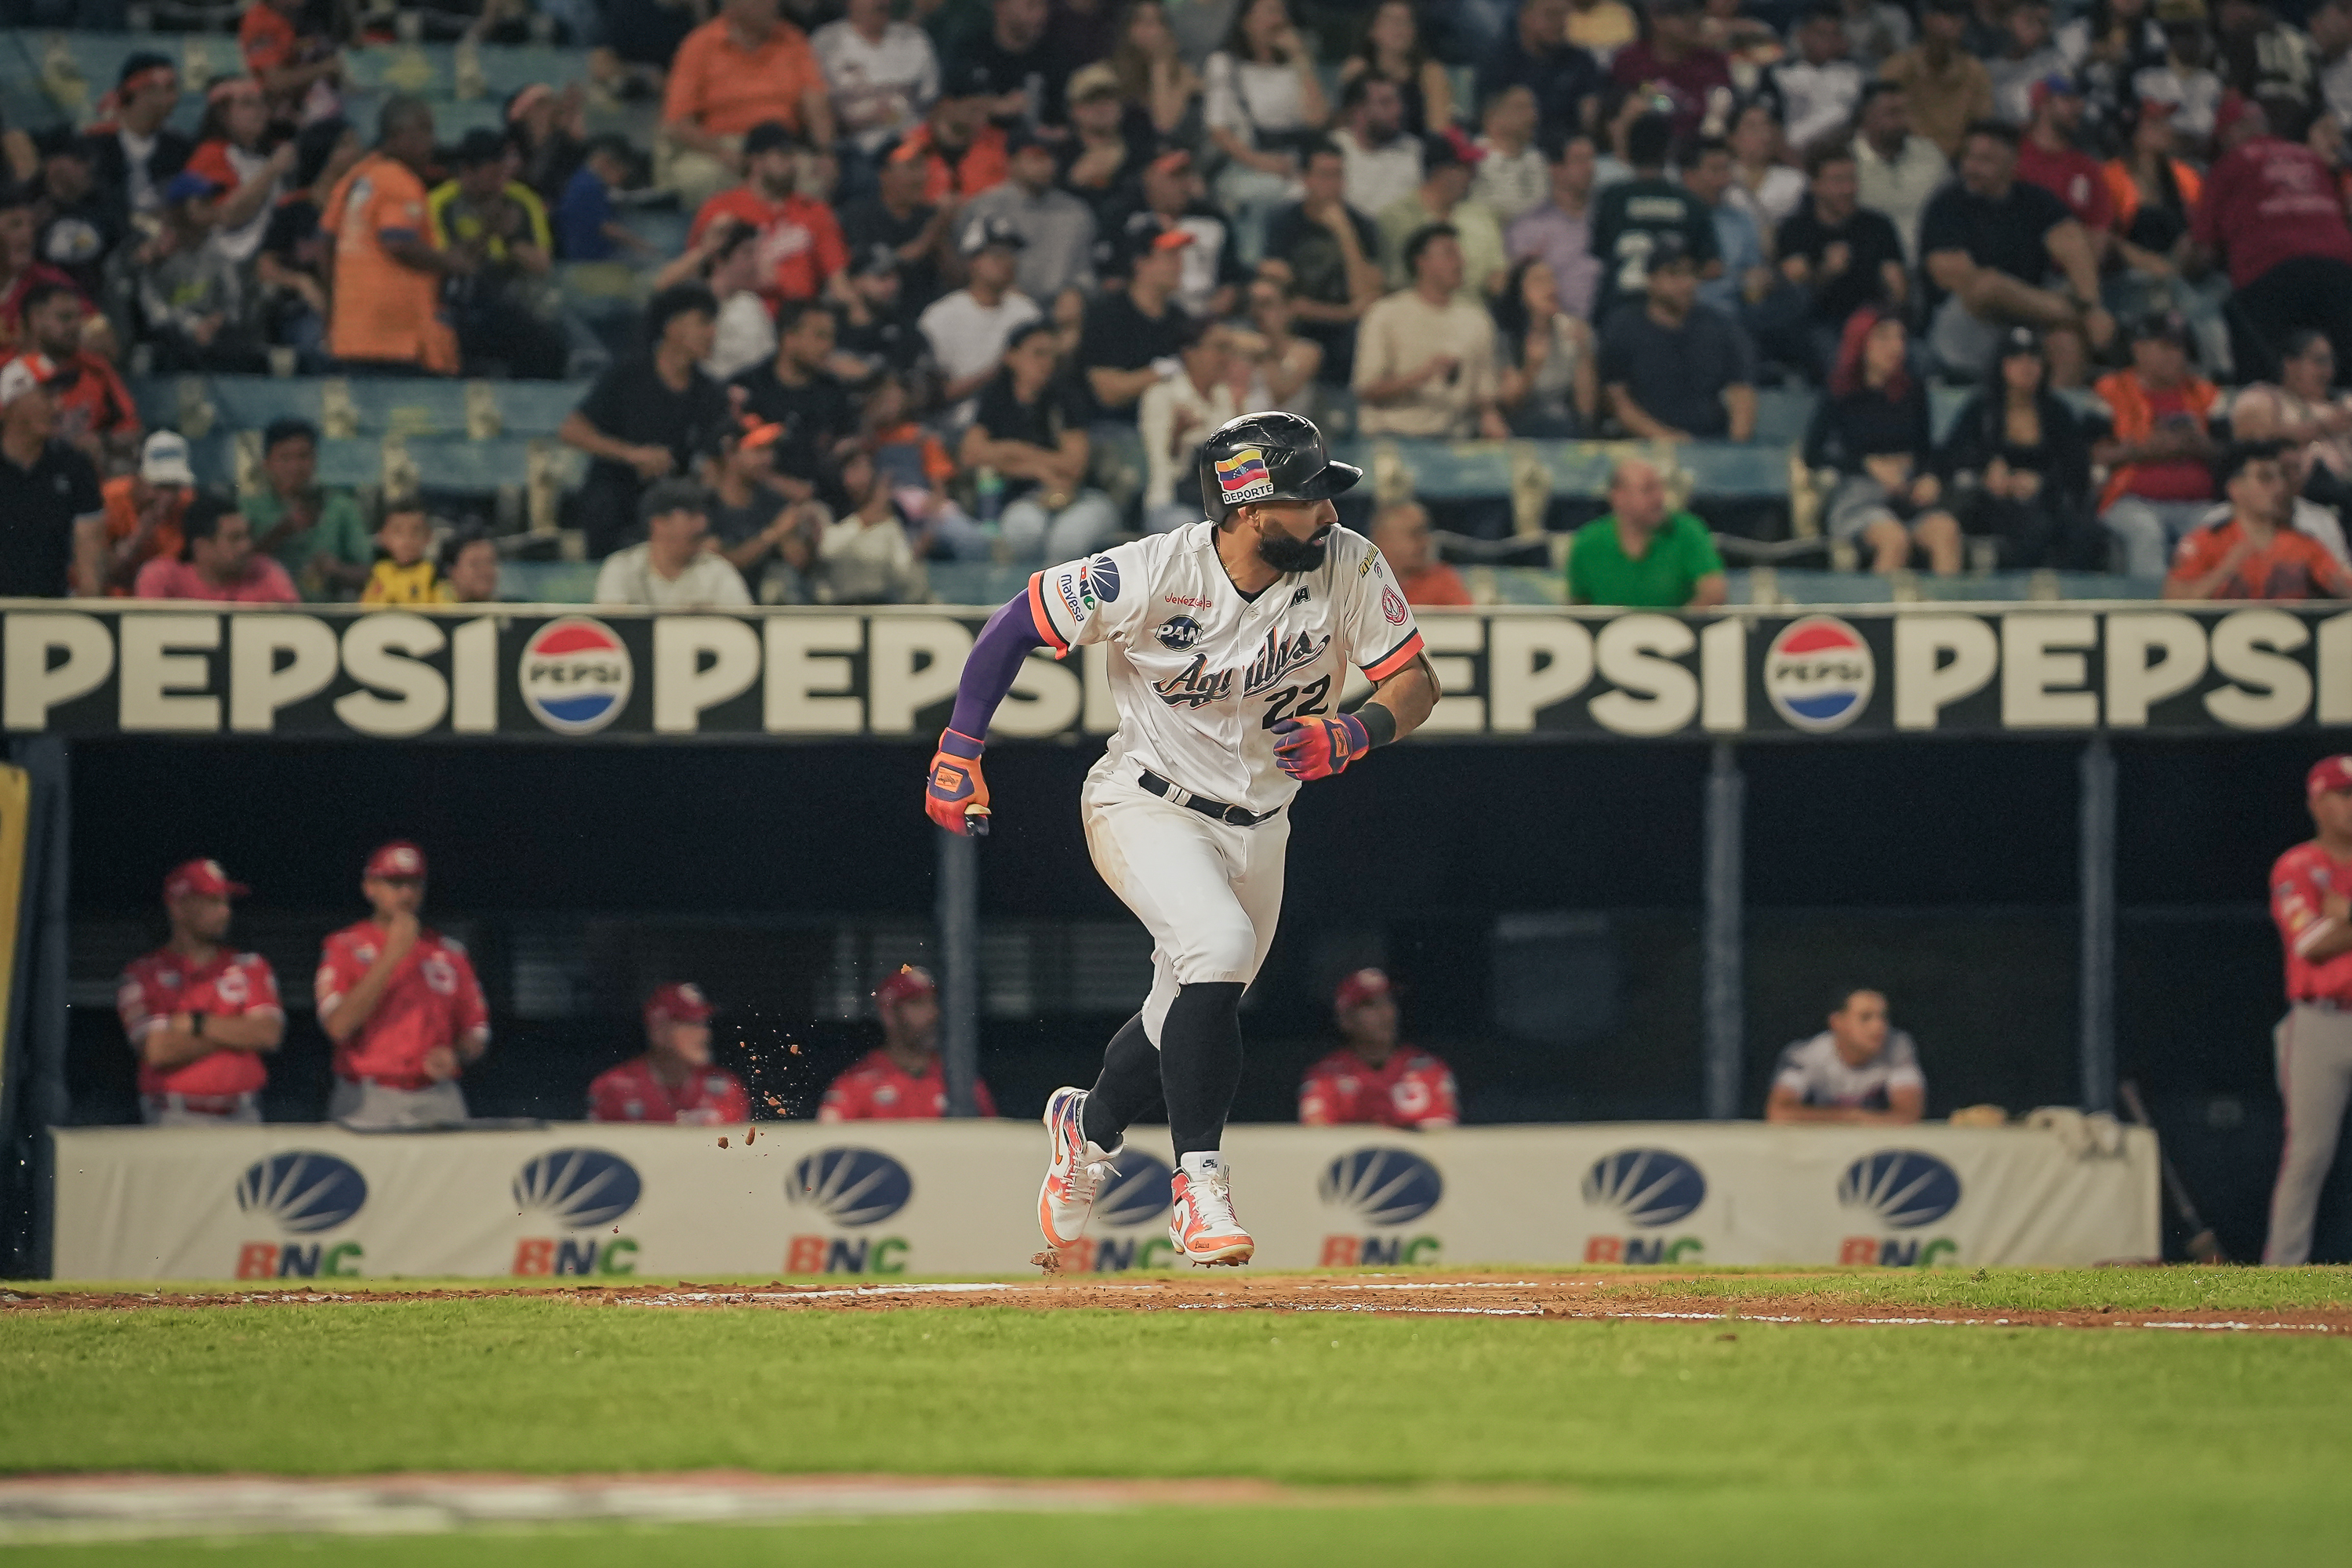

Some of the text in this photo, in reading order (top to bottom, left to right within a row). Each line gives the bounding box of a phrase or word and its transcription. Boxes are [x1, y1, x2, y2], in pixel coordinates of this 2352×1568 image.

[1224, 484, 1273, 503] DEPORTE
[3, 613, 499, 735] PEPSI
[529, 662, 622, 684] PEPSI
[1341, 614, 1748, 736] EPSI
[1777, 661, 1864, 682] PEPSI
[1261, 673, 1330, 730] 22
[236, 1241, 363, 1279] BNC
[514, 1238, 639, 1276] BNC
[785, 1235, 909, 1273] BNC
